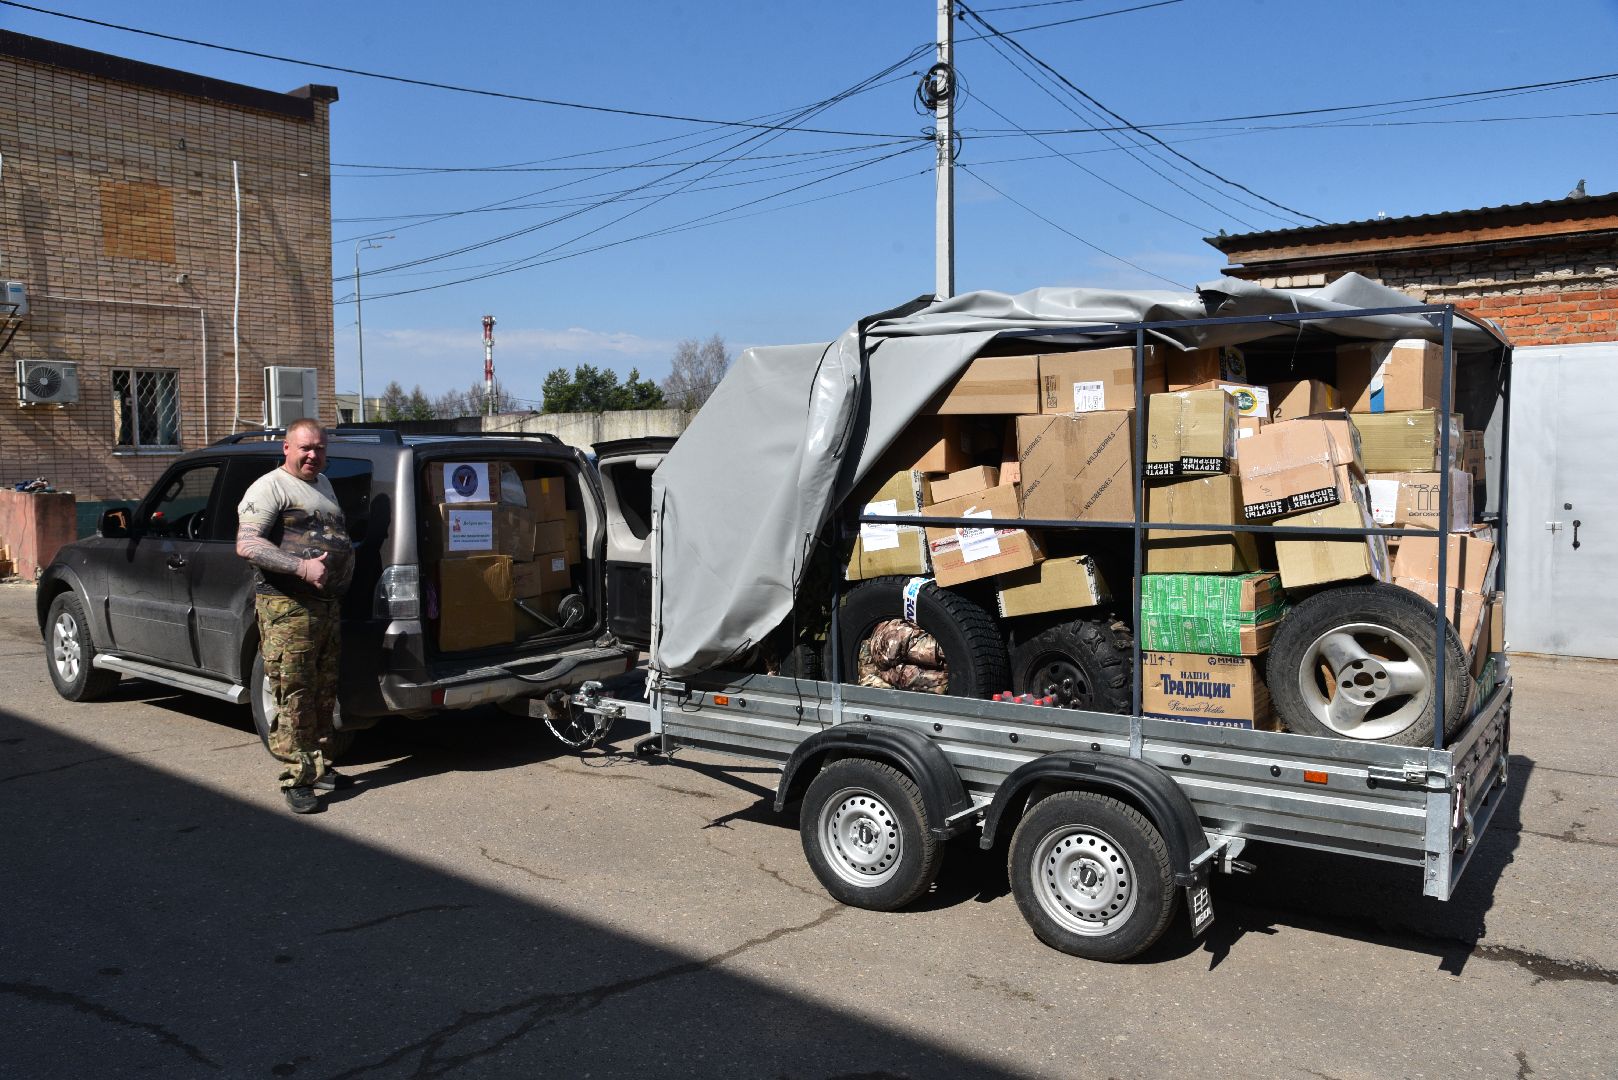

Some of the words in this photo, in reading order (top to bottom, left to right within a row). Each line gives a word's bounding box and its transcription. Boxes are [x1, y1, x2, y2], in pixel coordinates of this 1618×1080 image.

[1086, 432, 1116, 466] WILDBERRIES
[1182, 463, 1215, 471] КРУТЫХ
[1084, 478, 1112, 510] WILDBERRIES
[1294, 495, 1329, 509] КРУТЫХ
[1180, 671, 1210, 680] НАШИ
